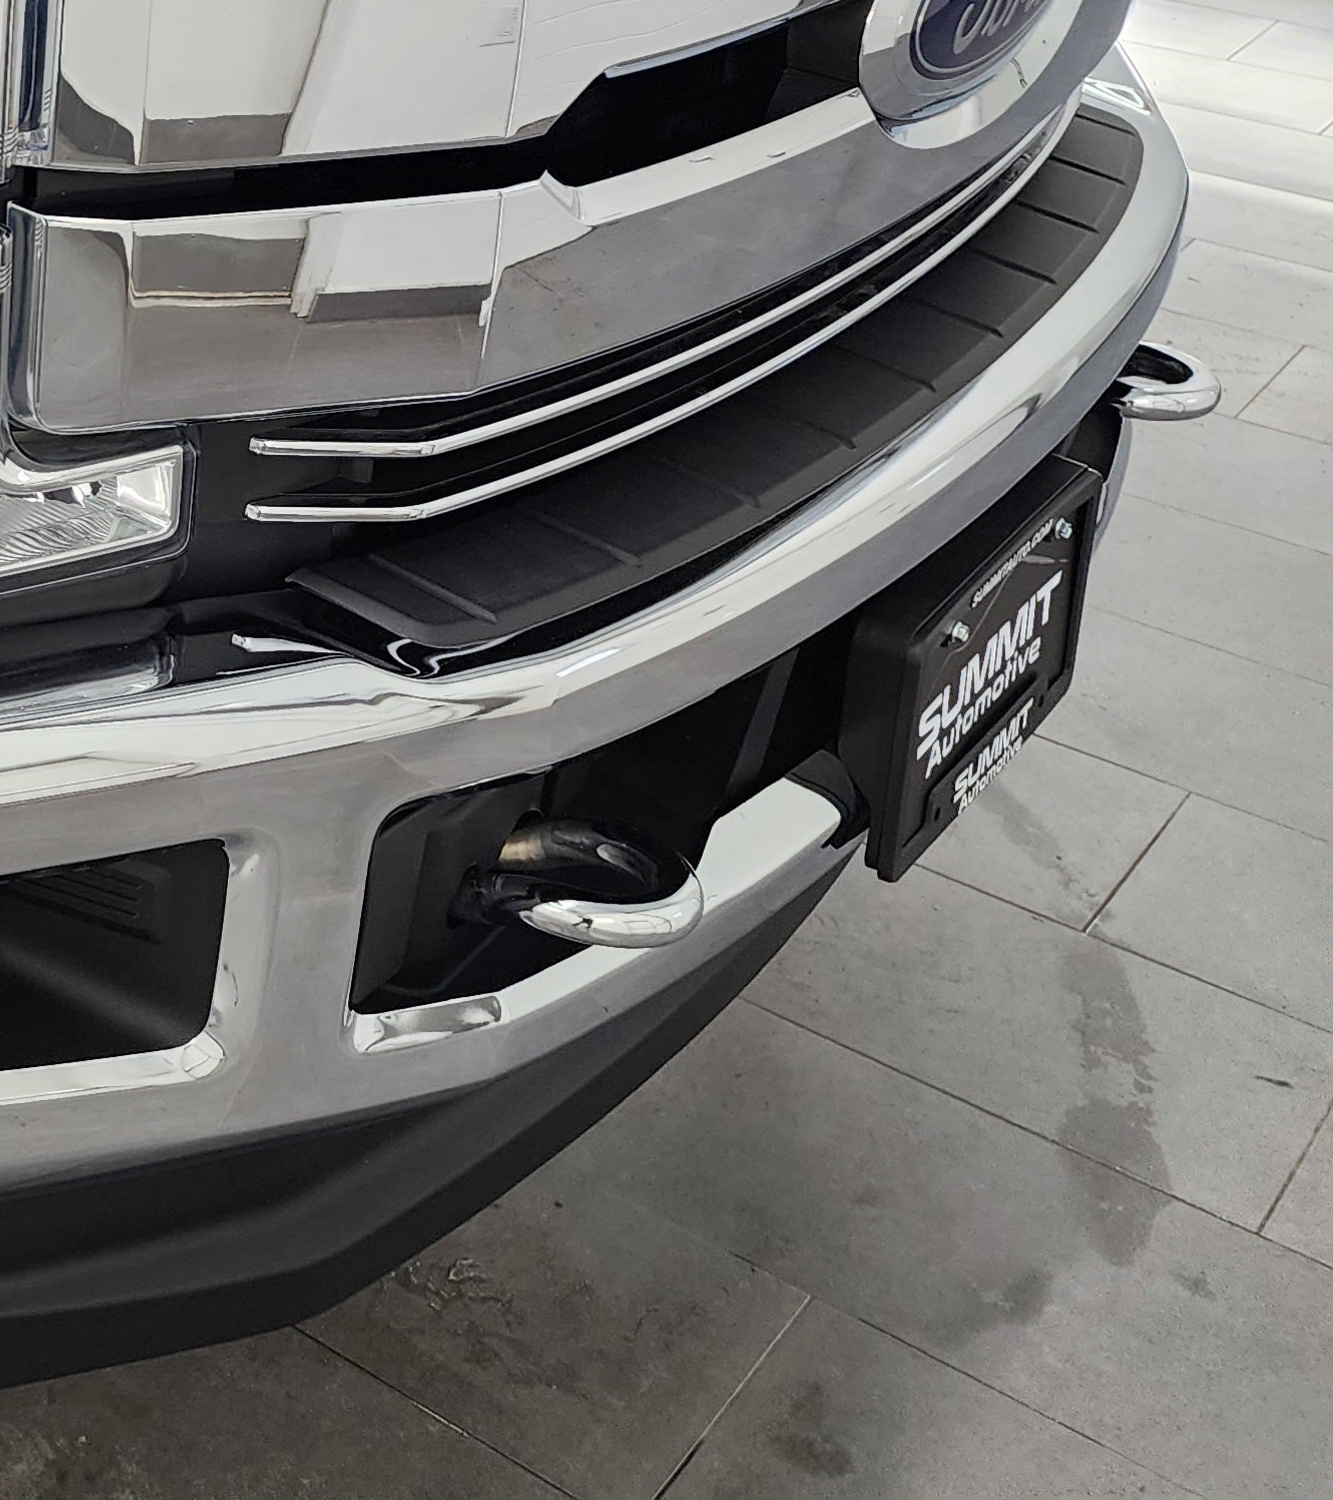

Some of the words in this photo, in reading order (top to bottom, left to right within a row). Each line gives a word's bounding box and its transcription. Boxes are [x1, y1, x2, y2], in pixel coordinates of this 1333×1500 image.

[916, 568, 1064, 761] SUMMIT
[924, 635, 1042, 780] Automotive
[952, 696, 1034, 804] SUMMIT
[957, 734, 1024, 817] Automotive
